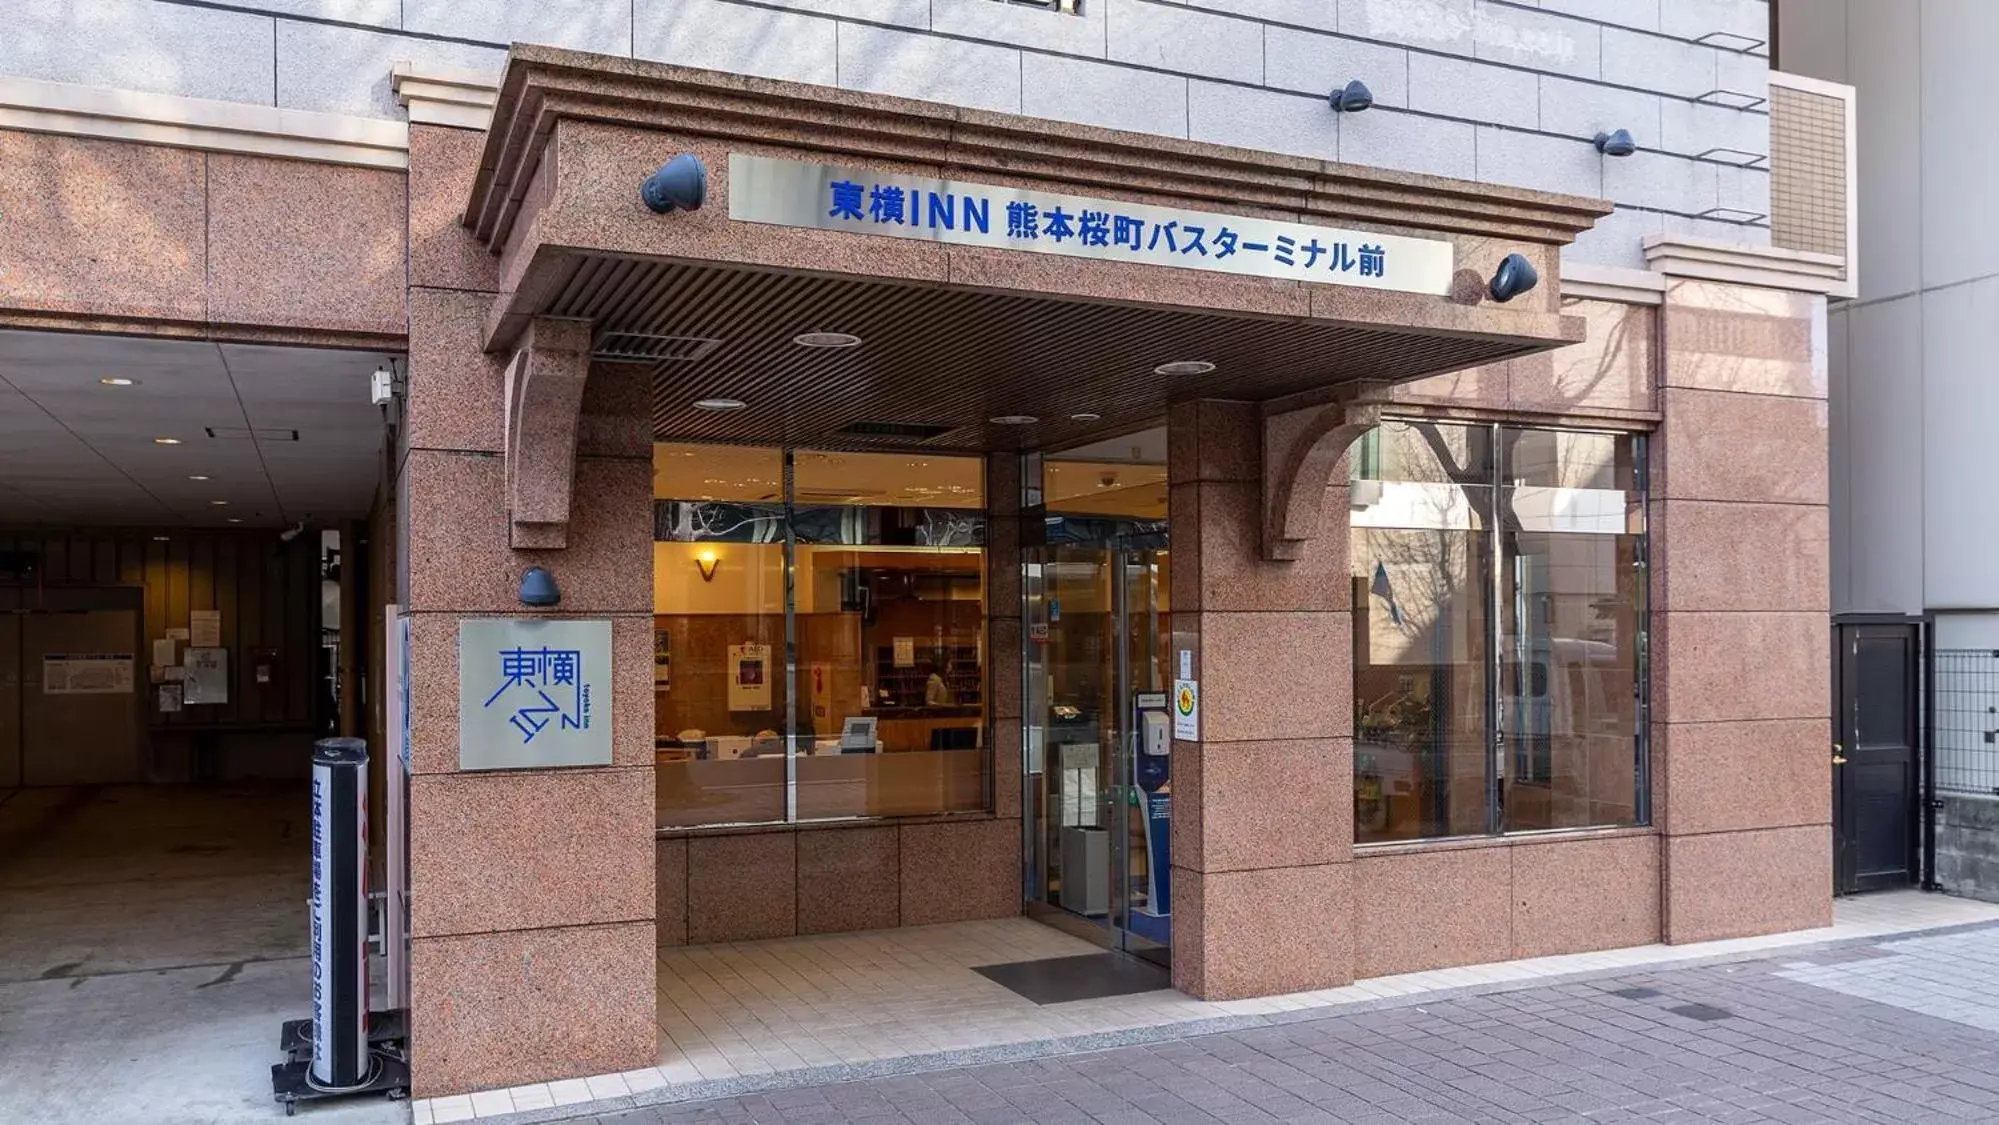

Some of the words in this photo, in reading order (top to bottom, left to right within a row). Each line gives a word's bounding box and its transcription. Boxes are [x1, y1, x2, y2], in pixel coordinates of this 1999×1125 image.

[829, 180, 989, 234] 東横INN
[1006, 201, 1385, 278] 熊本桜町バスターミナル前
